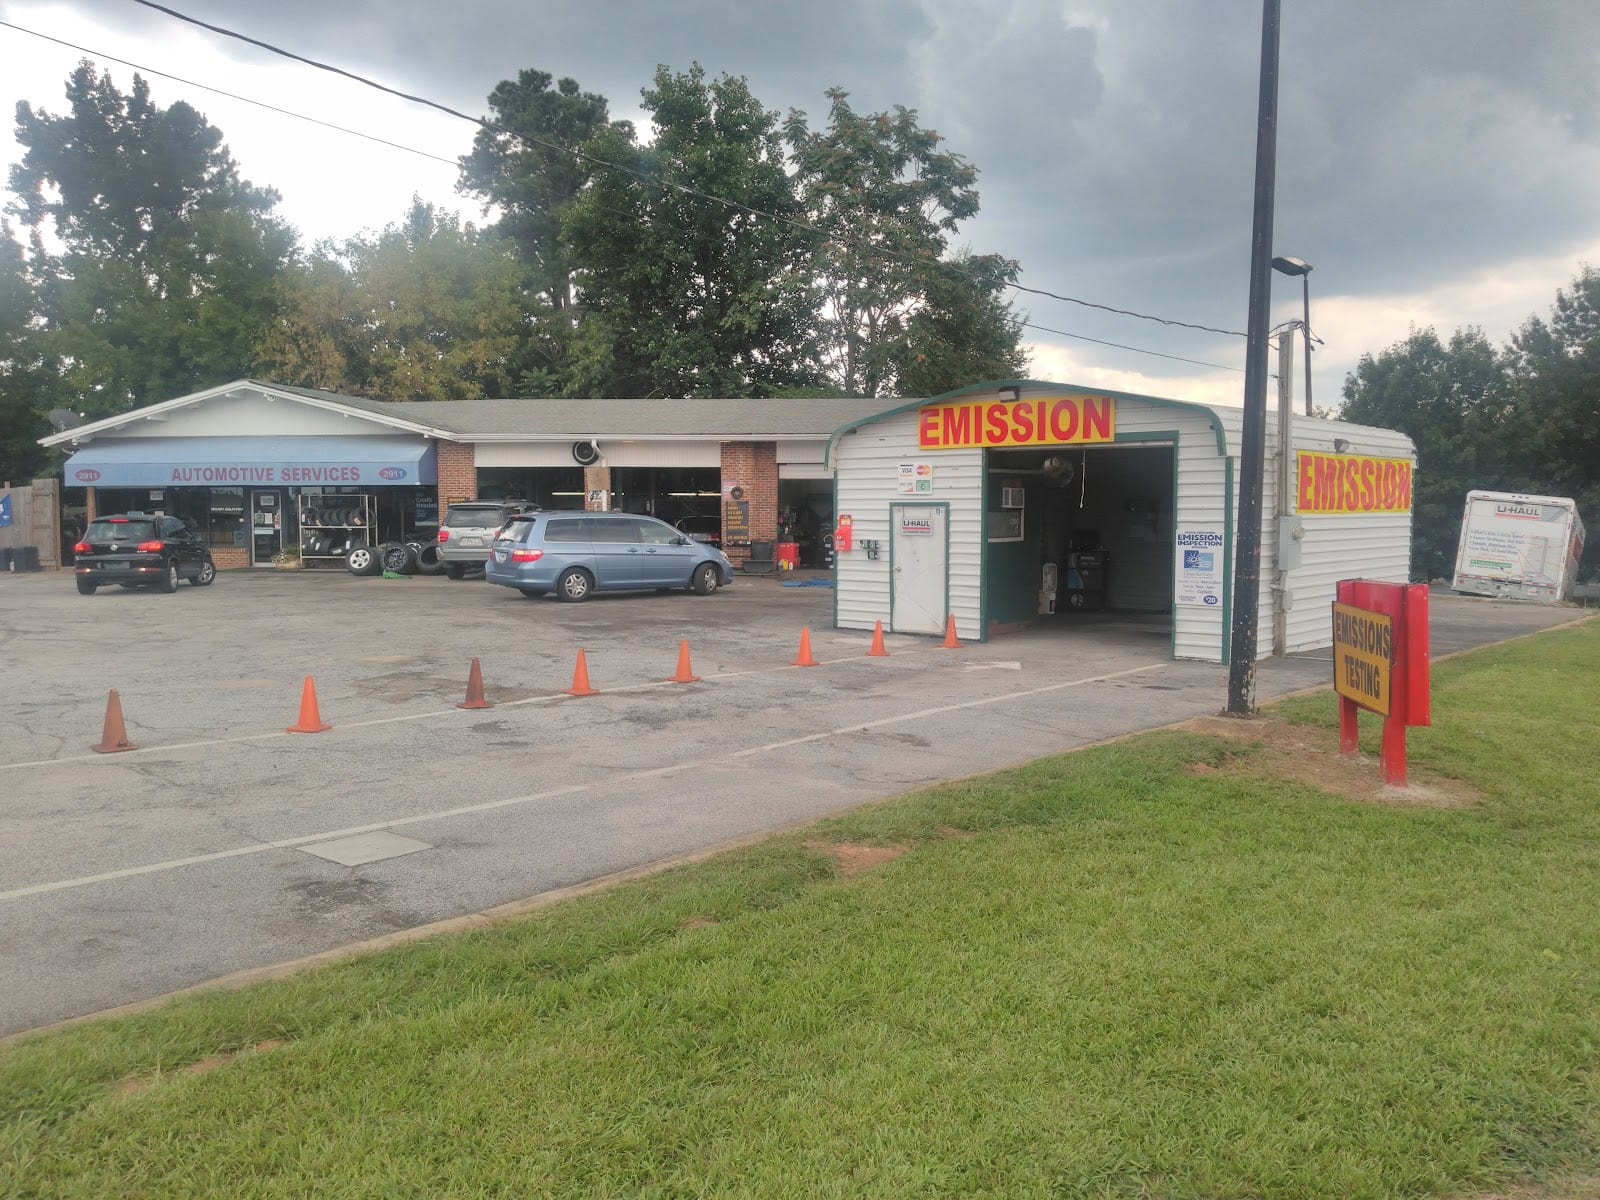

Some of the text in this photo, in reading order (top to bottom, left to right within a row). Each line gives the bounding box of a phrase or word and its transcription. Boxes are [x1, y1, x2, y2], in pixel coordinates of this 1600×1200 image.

[920, 398, 1111, 446] EMISSION
[171, 467, 360, 482] AUTOMOTIVE SERVICES
[1299, 455, 1411, 511] EMISSION
[1497, 505, 1540, 516] U-HAUL
[1205, 596, 1216, 604] $20
[1335, 611, 1390, 660] EMISSIONS
[1344, 654, 1380, 700] TESTING
